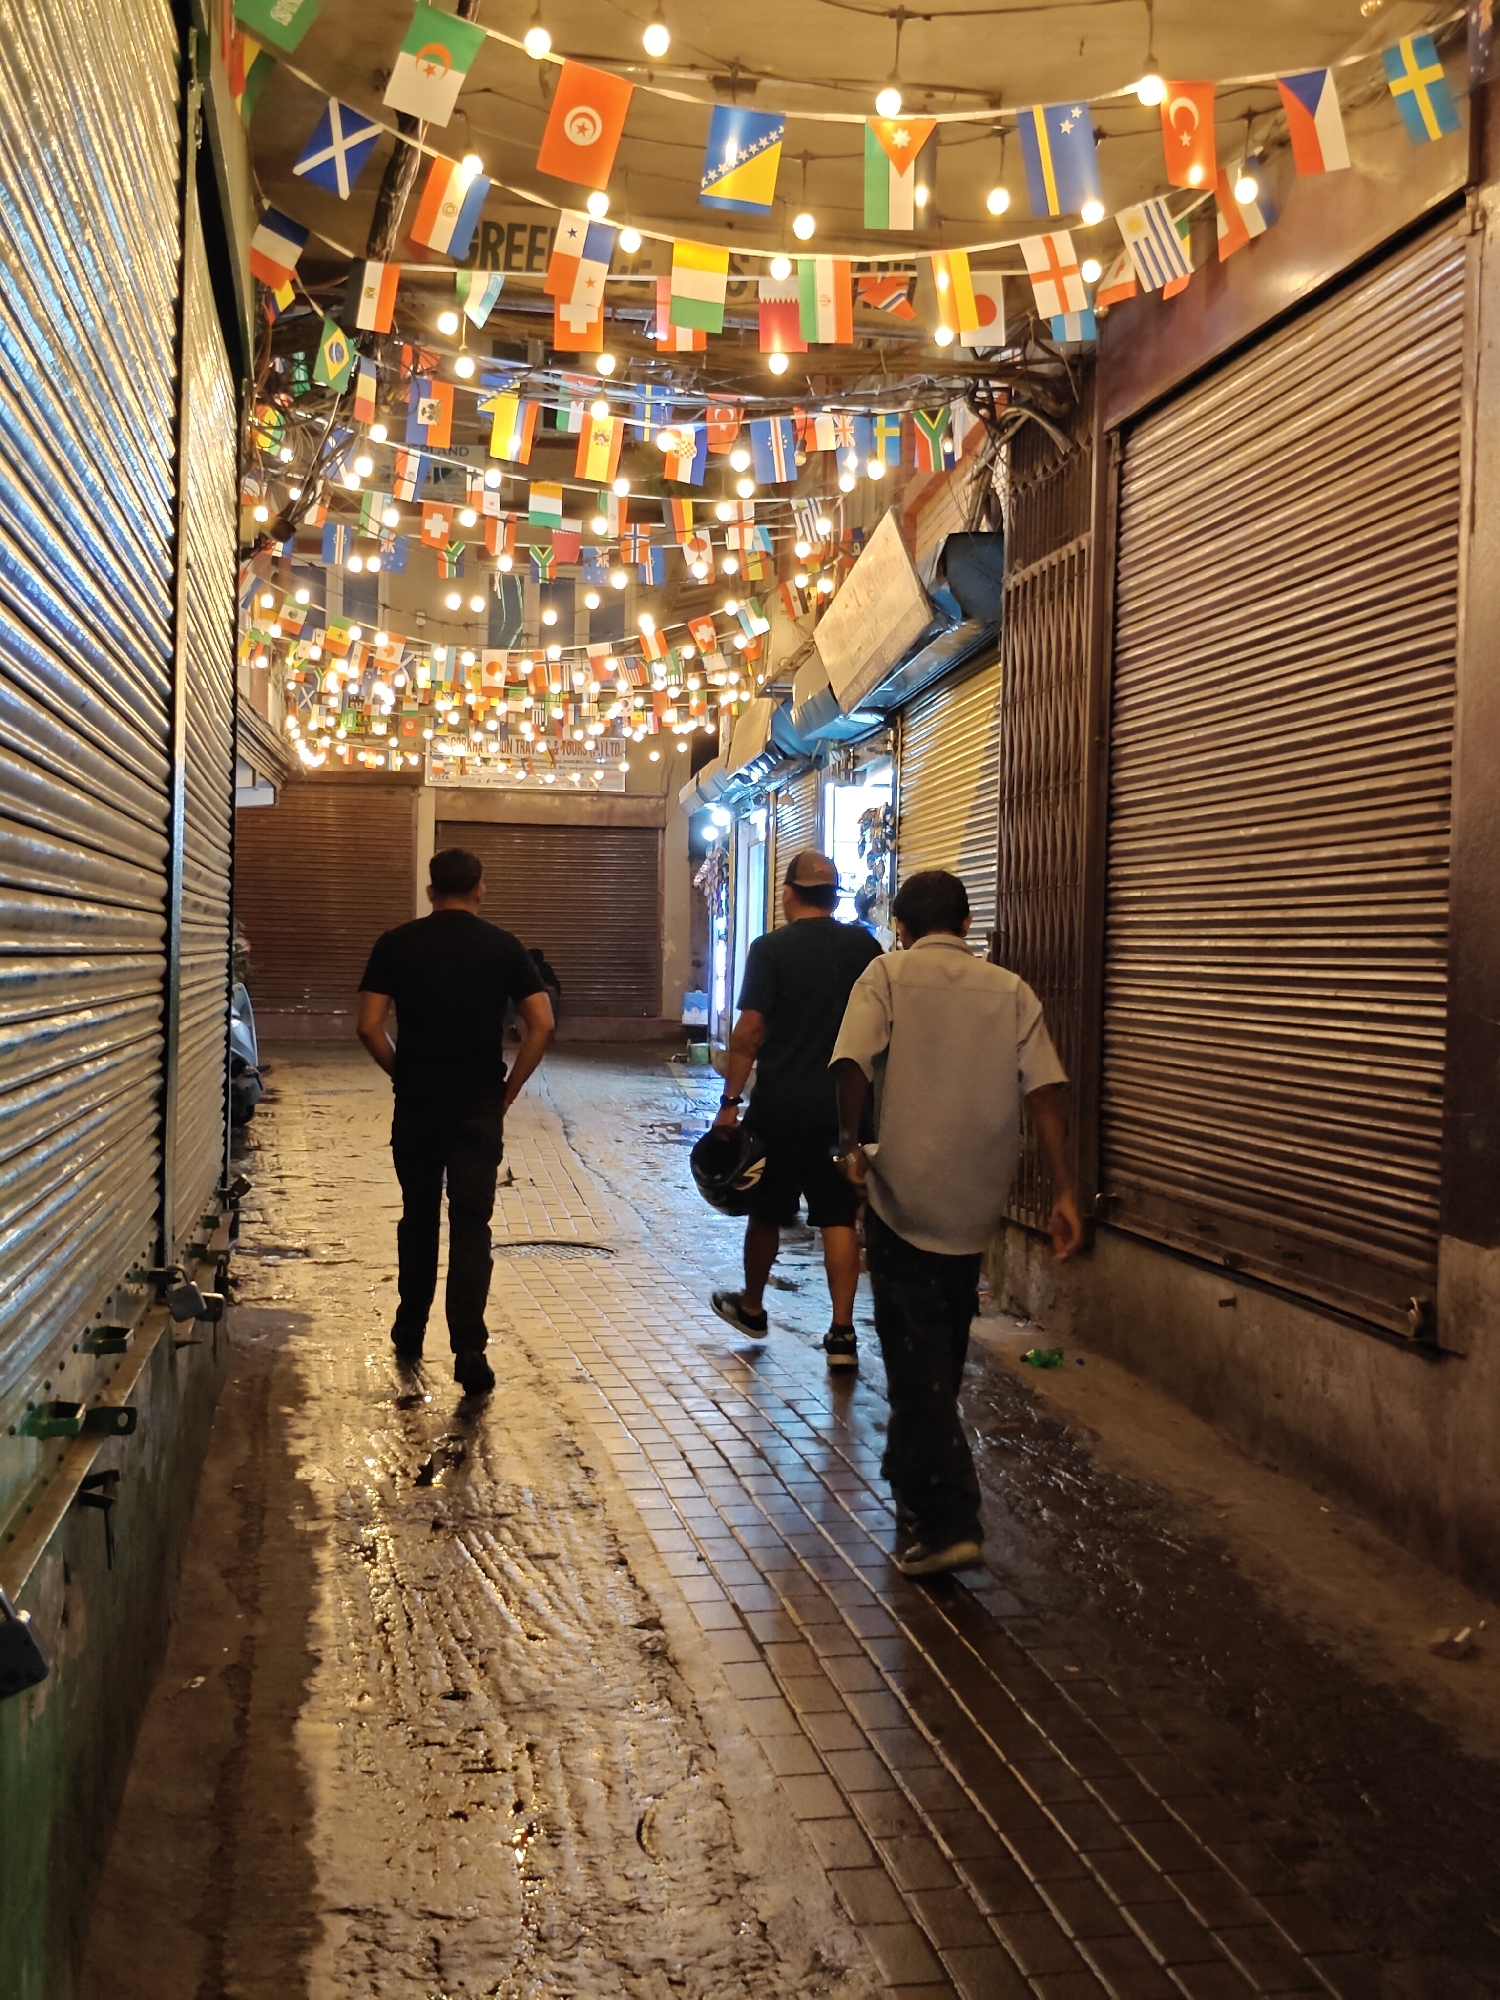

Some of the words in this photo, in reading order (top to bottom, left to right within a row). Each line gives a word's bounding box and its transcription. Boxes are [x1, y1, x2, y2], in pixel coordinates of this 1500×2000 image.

[453, 220, 560, 273] GREE
[516, 738, 551, 755] TRAVS
[562, 740, 587, 757] TOURS
[606, 741, 622, 757] LTD.
